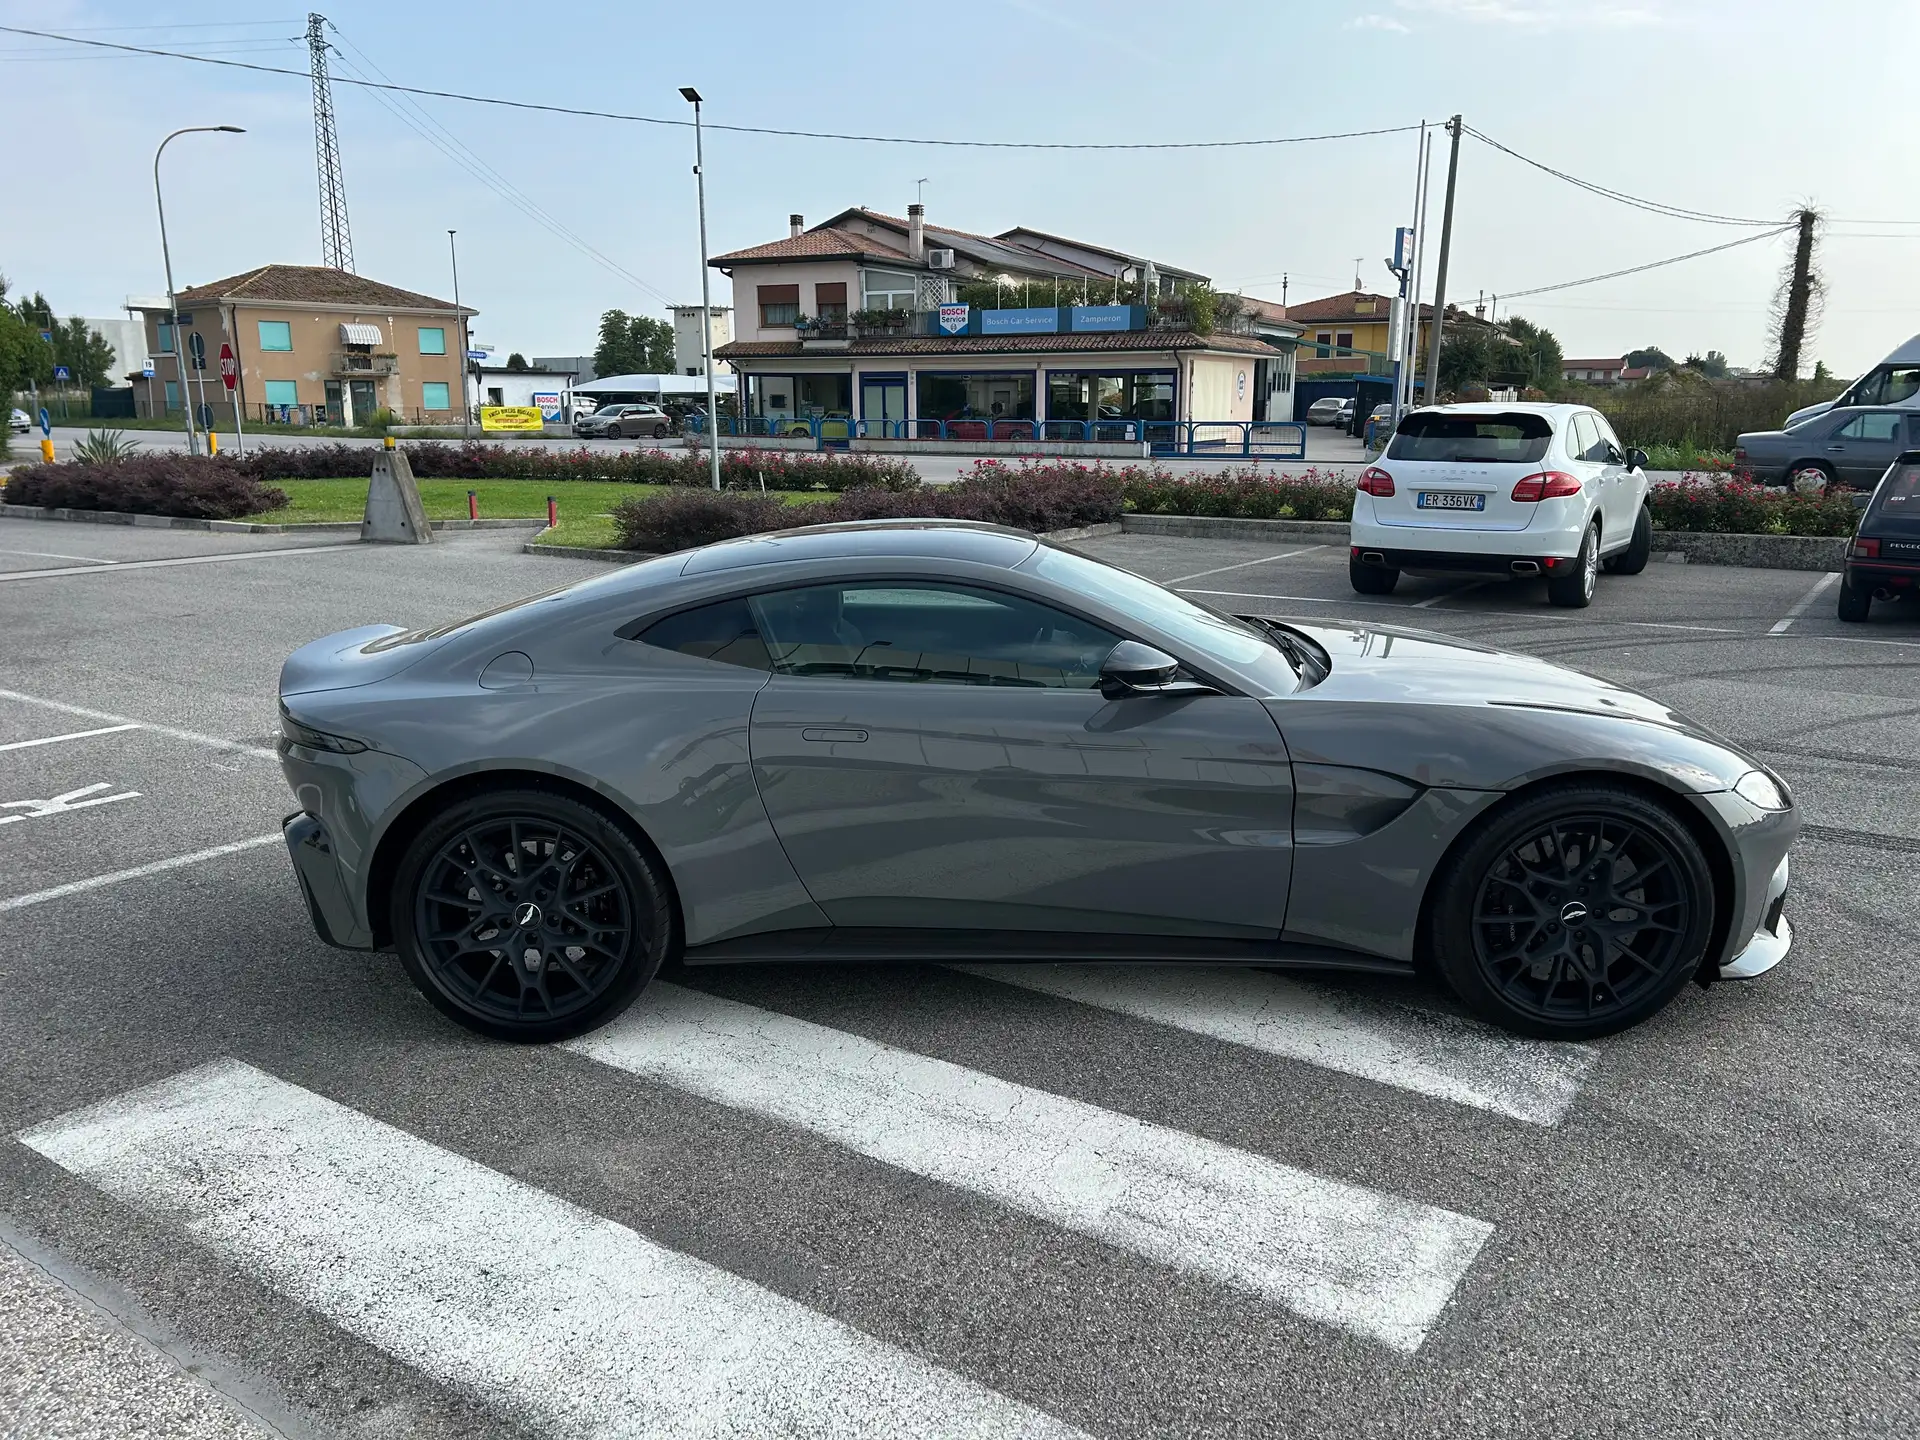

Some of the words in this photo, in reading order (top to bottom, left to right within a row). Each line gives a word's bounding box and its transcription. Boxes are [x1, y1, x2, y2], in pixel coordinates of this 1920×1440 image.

[941, 308, 966, 316] BOSCH
[986, 317, 1009, 325] Bosch
[1010, 317, 1024, 325] Car
[1025, 316, 1053, 325] Service
[1080, 315, 1121, 324] Zampieron
[220, 358, 235, 376] STOP
[536, 396, 558, 404] BOSCH
[1425, 494, 1439, 506] ER
[1442, 495, 1477, 508] 336VK
